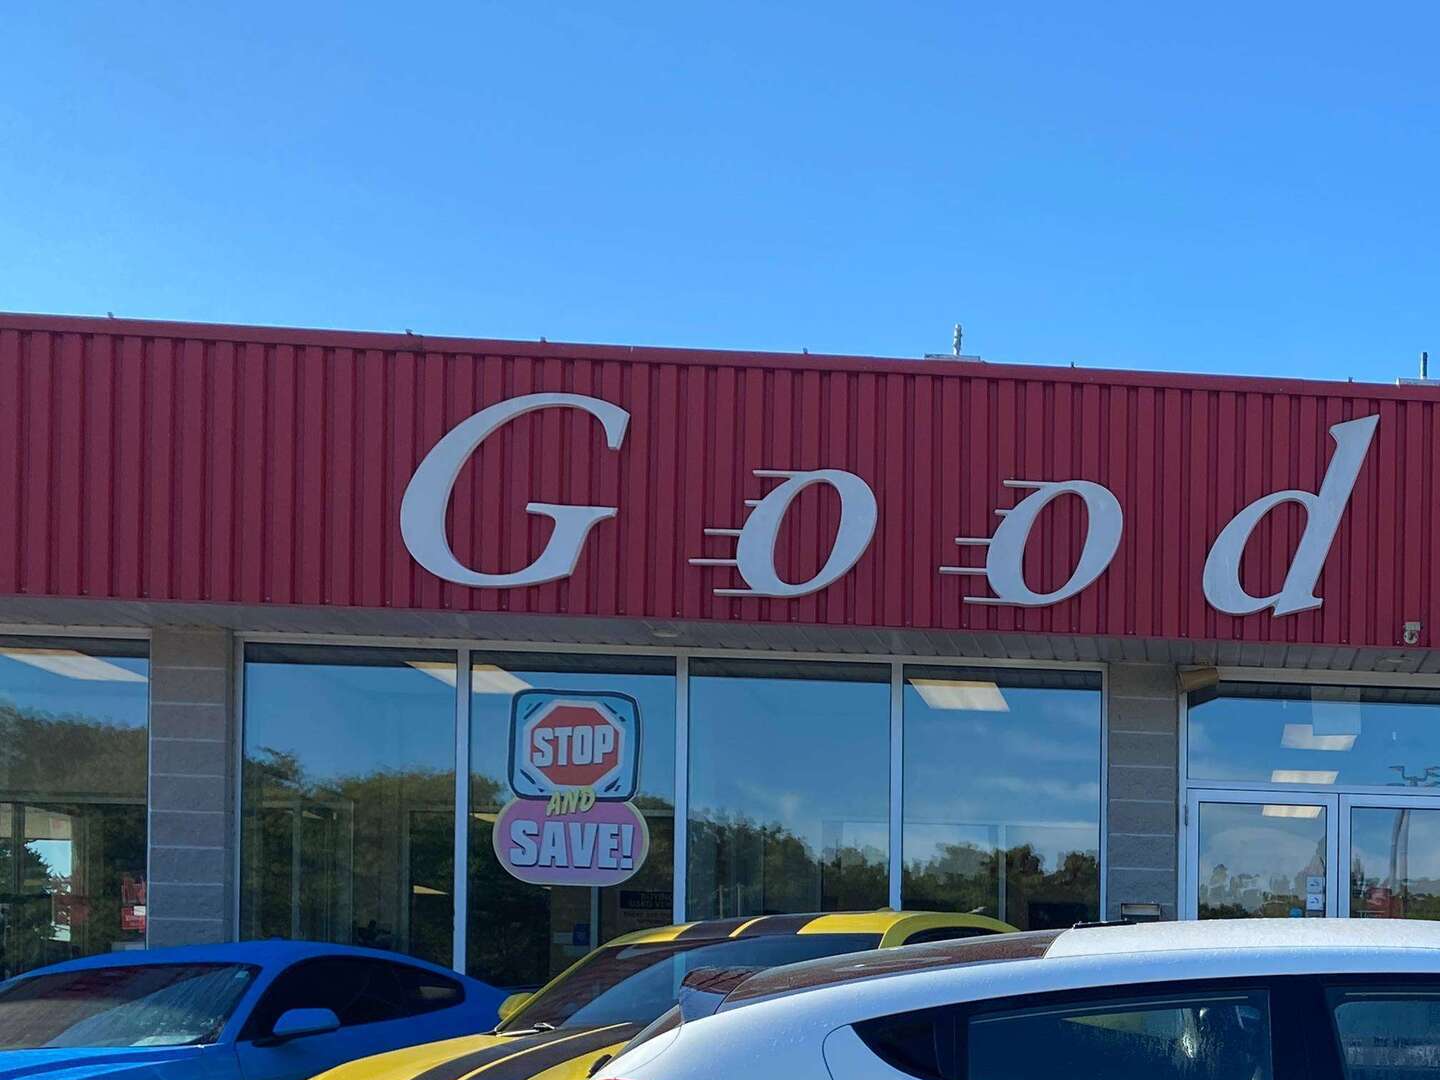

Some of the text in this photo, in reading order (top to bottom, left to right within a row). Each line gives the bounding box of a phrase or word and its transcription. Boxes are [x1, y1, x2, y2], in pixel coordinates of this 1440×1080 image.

[532, 724, 616, 768] STOP
[546, 787, 596, 816] AND
[510, 819, 634, 871] SAVE!
